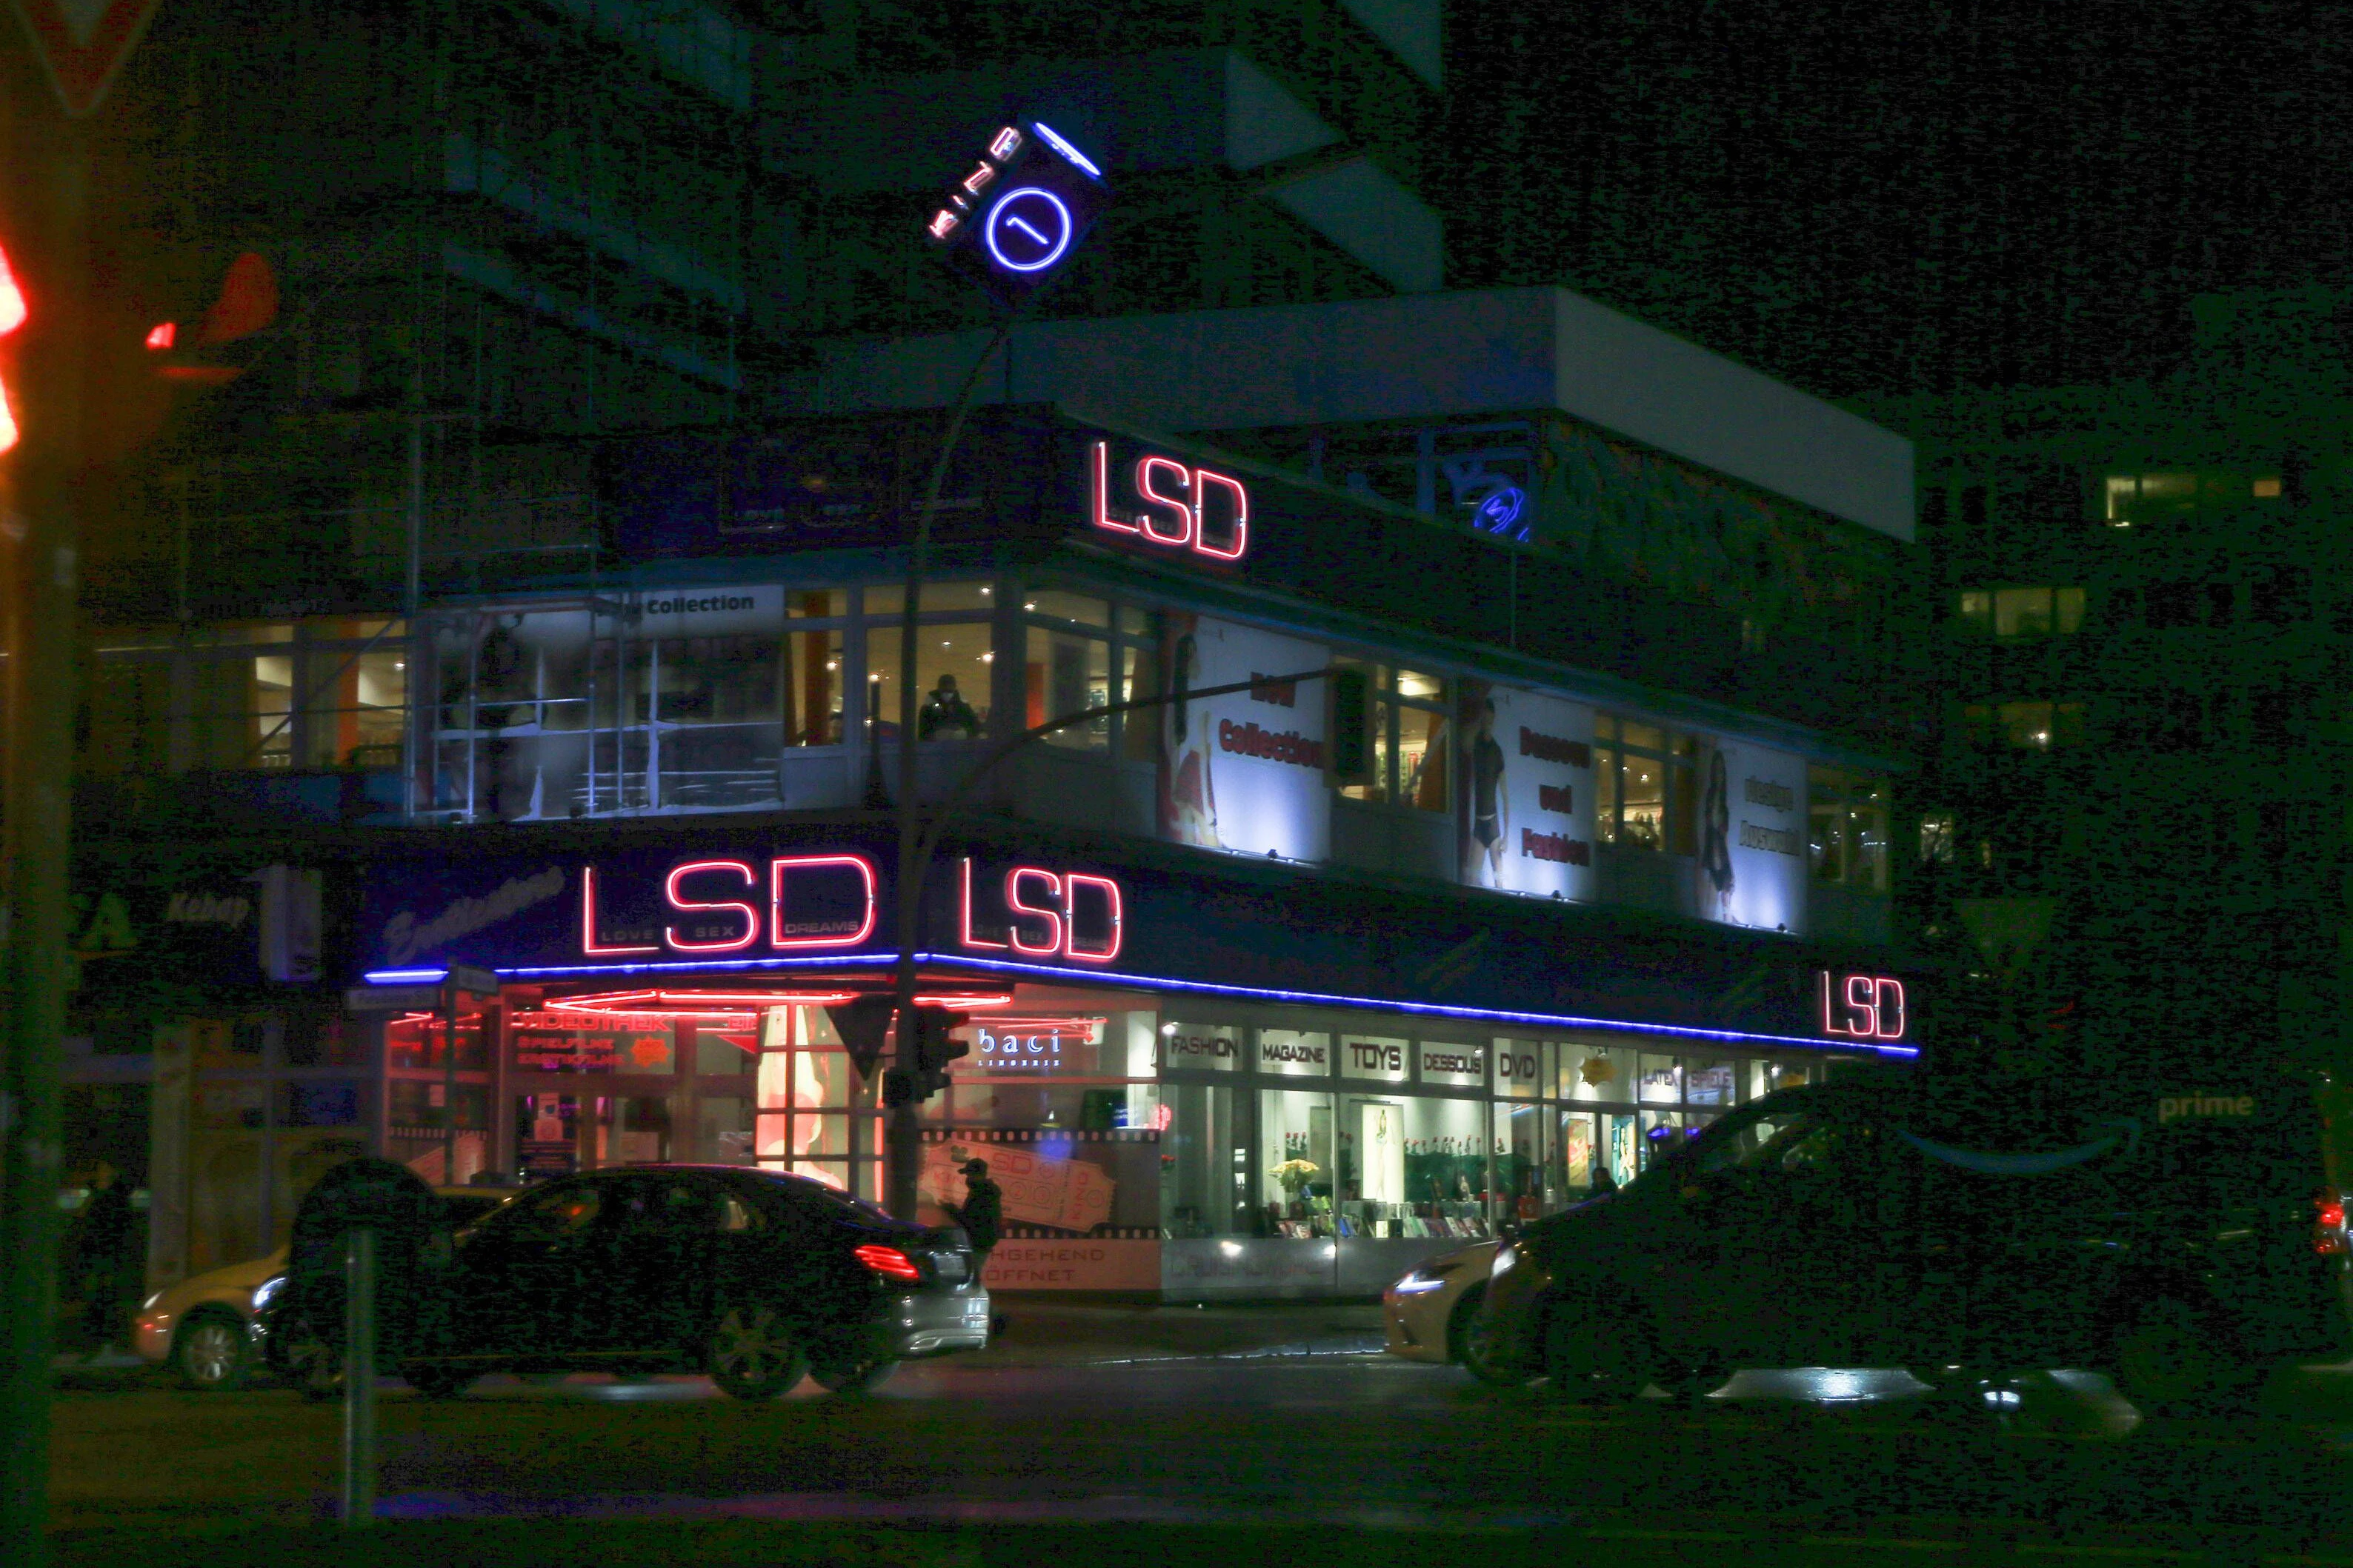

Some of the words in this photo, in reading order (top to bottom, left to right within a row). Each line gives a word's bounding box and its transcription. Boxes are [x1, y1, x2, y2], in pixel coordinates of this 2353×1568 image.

[1090, 441, 1248, 561] LSD
[647, 595, 755, 614] Collection
[581, 855, 876, 954] LSD
[958, 855, 1122, 961] LSD
[601, 929, 655, 943] LOVE
[695, 925, 736, 938] SEX
[784, 920, 860, 935] DREAMS
[1821, 970, 1905, 1038] LSD
[978, 1028, 1061, 1053] baci
[1171, 1036, 1239, 1058] FASHION
[1262, 1043, 1325, 1064] MAGAZINE
[1349, 1042, 1402, 1070] TOYS
[1423, 1053, 1482, 1074] DESSOUS
[1500, 1052, 1536, 1078] DVD
[2158, 1090, 2254, 1123] prime
